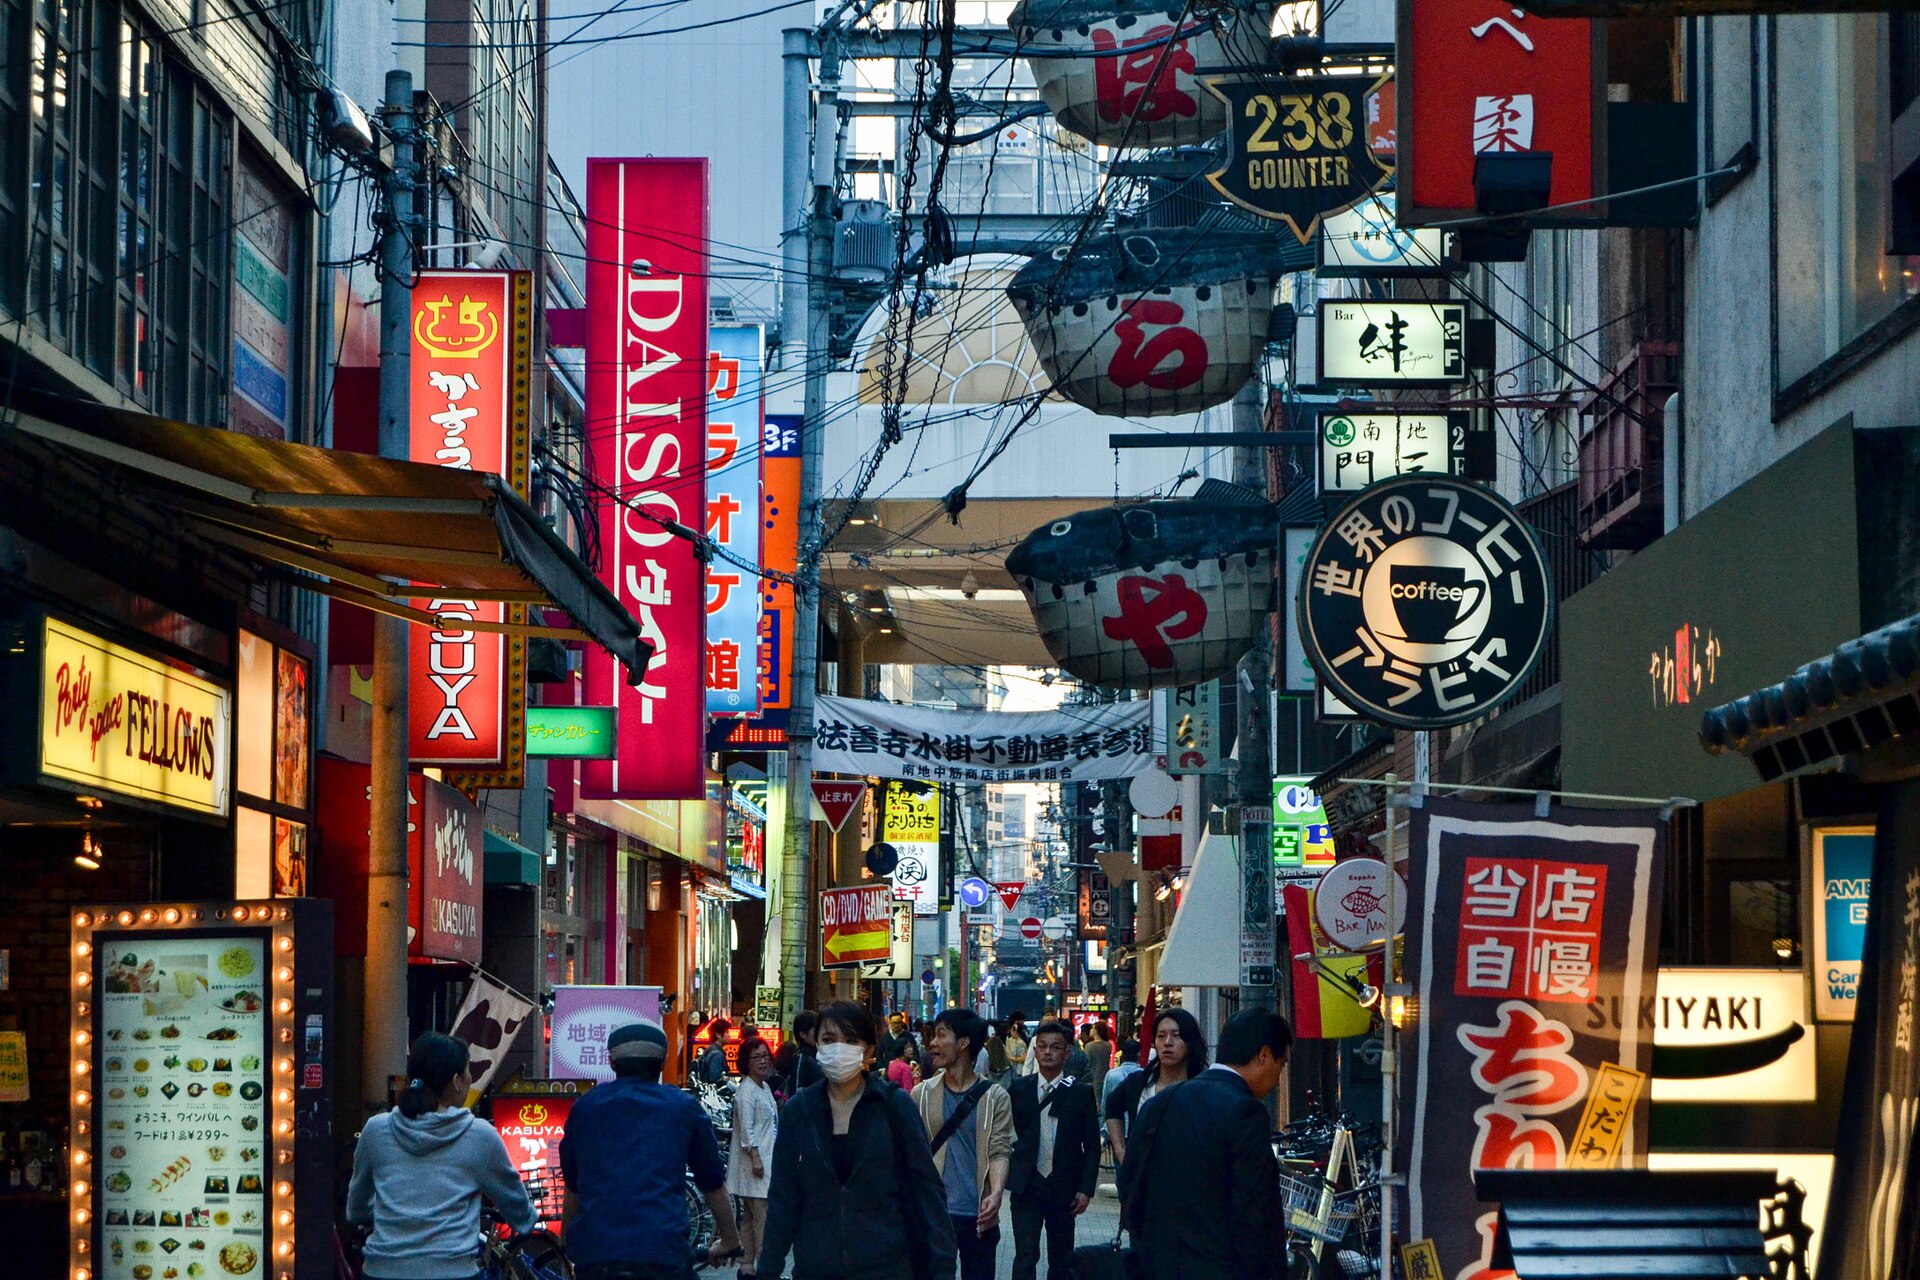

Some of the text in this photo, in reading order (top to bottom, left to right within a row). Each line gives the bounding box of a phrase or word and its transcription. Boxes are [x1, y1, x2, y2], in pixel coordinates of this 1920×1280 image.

[1245, 91, 1354, 153] 238
[1248, 156, 1350, 190] COUNTER
[1353, 231, 1382, 241] BAR
[1334, 309, 1356, 321] Bar
[1109, 299, 1208, 390] ら
[1358, 310, 1409, 373] 絆
[1444, 320, 1461, 369] 2F
[624, 271, 684, 547] DAISO
[763, 423, 798, 452] 3F
[1363, 420, 1429, 441] 南地
[1313, 488, 1524, 604] 世界のコーヒー
[1390, 581, 1464, 602] coffee
[1102, 573, 1208, 669] や
[126, 689, 214, 781] FELLOWS
[820, 790, 854, 803] 止まれ
[887, 813, 935, 830] よりみち
[823, 890, 890, 926] CD/DVD/GAME
[1466, 864, 1597, 923] 当店
[438, 897, 477, 938] KASUYA
[1466, 937, 1591, 998] 自慢
[1586, 994, 1763, 1030] SUKIYAKI
[501, 1125, 565, 1136] KASUYA
